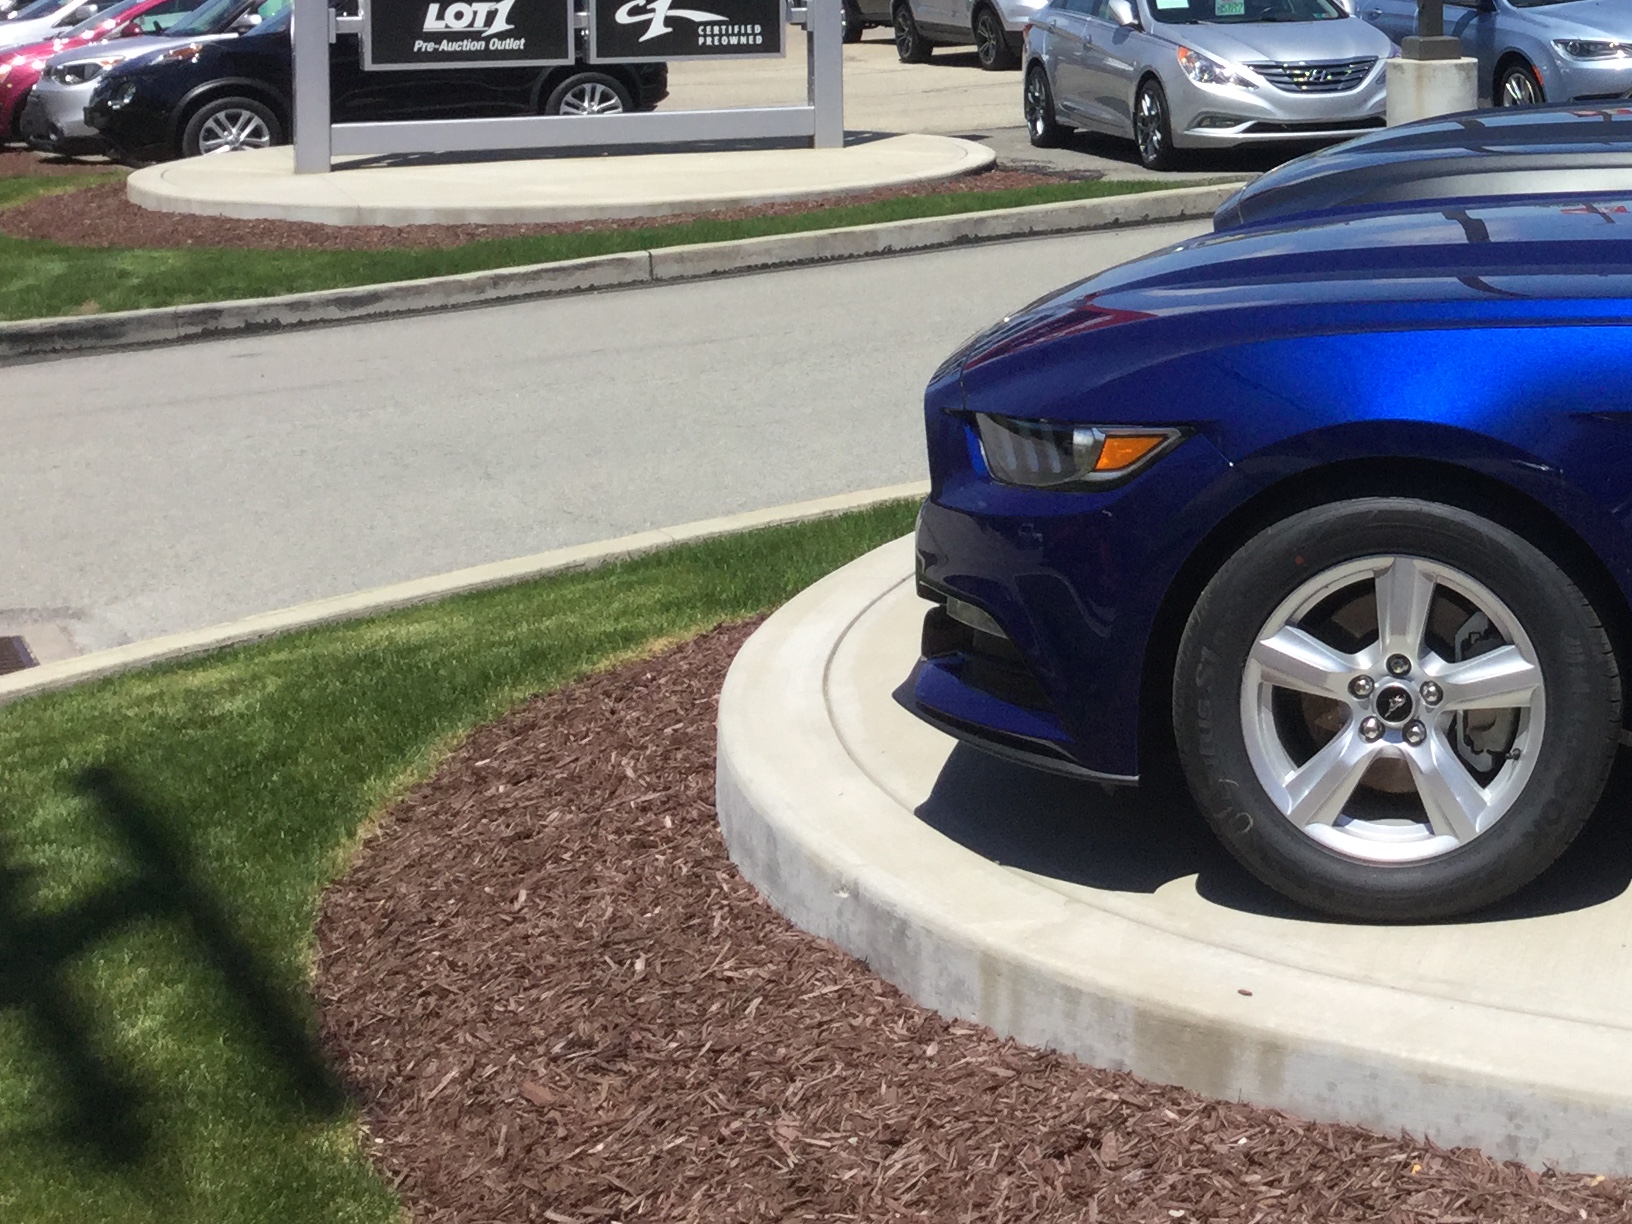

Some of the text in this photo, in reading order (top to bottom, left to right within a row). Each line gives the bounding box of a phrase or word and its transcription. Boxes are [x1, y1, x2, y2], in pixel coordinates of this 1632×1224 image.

[698, 24, 762, 35] CERTIFIED
[414, 36, 526, 53] Pre-Auction Outlet
[698, 35, 763, 46] PREOWNED
